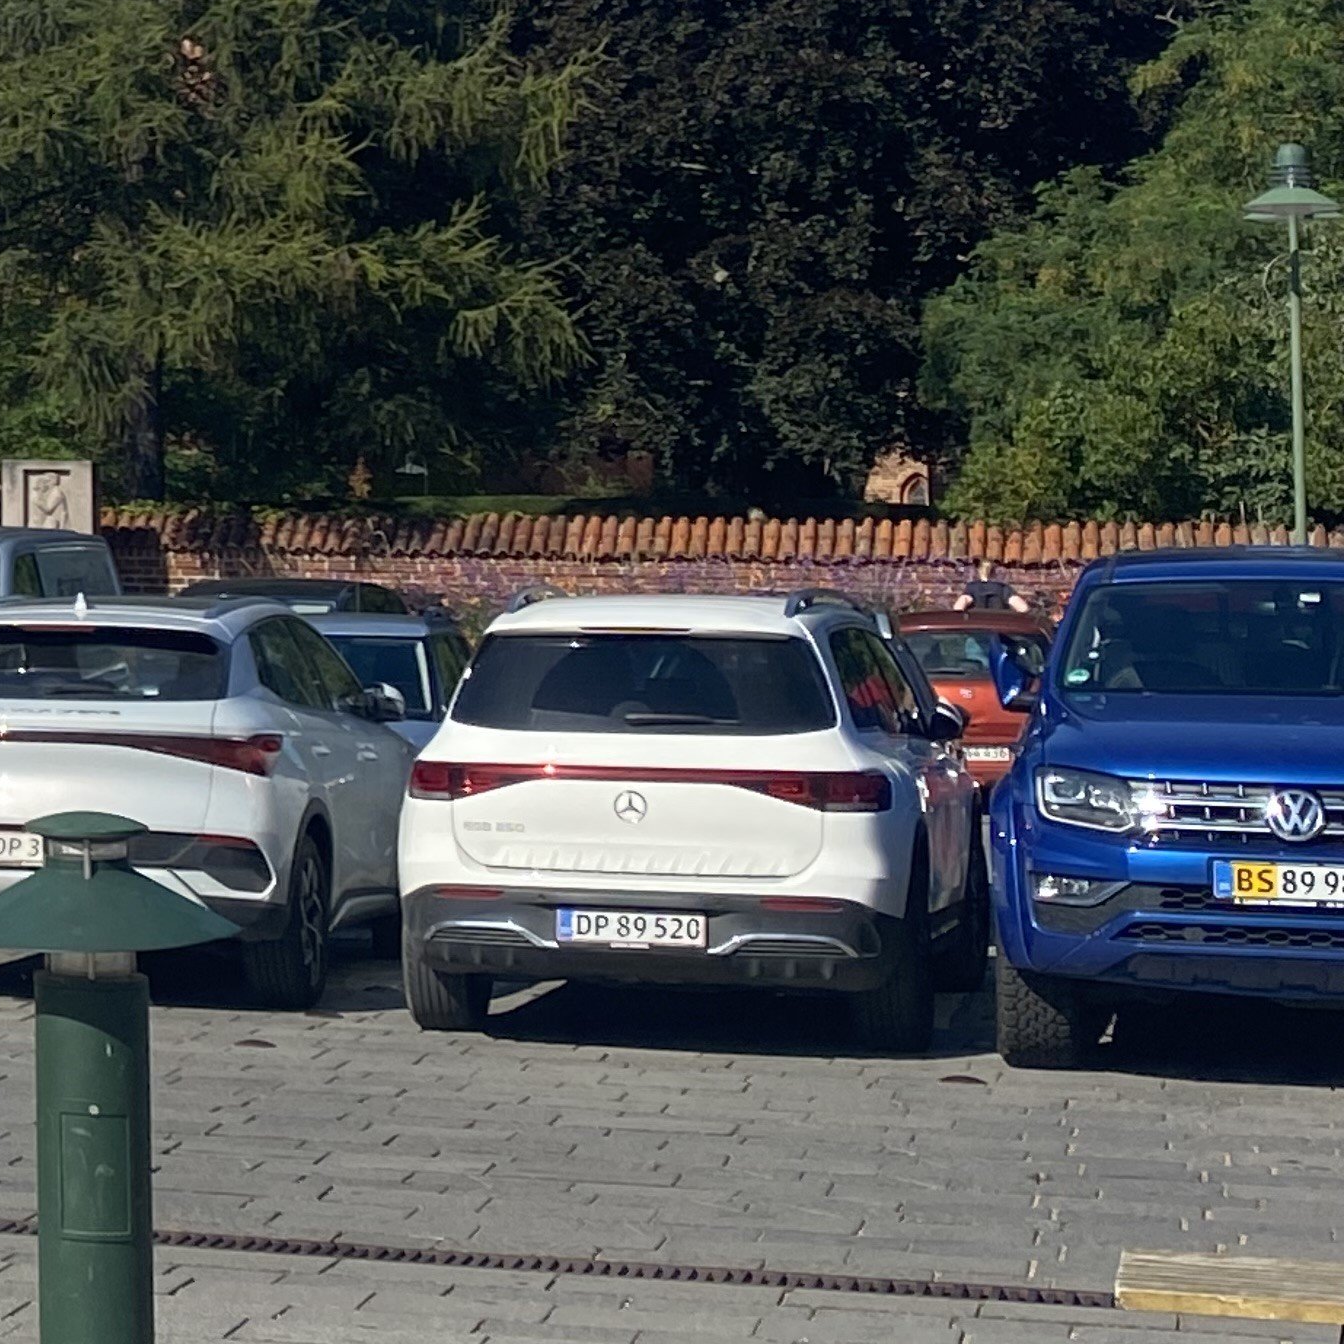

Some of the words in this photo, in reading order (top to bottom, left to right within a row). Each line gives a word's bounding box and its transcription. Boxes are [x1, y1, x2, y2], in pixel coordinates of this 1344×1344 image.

[1237, 867, 1275, 893] BS
[1282, 869, 1316, 896] 89
[1324, 870, 1344, 896] 9
[576, 914, 609, 936] DP
[616, 915, 647, 939] 89
[654, 917, 700, 940] 520
